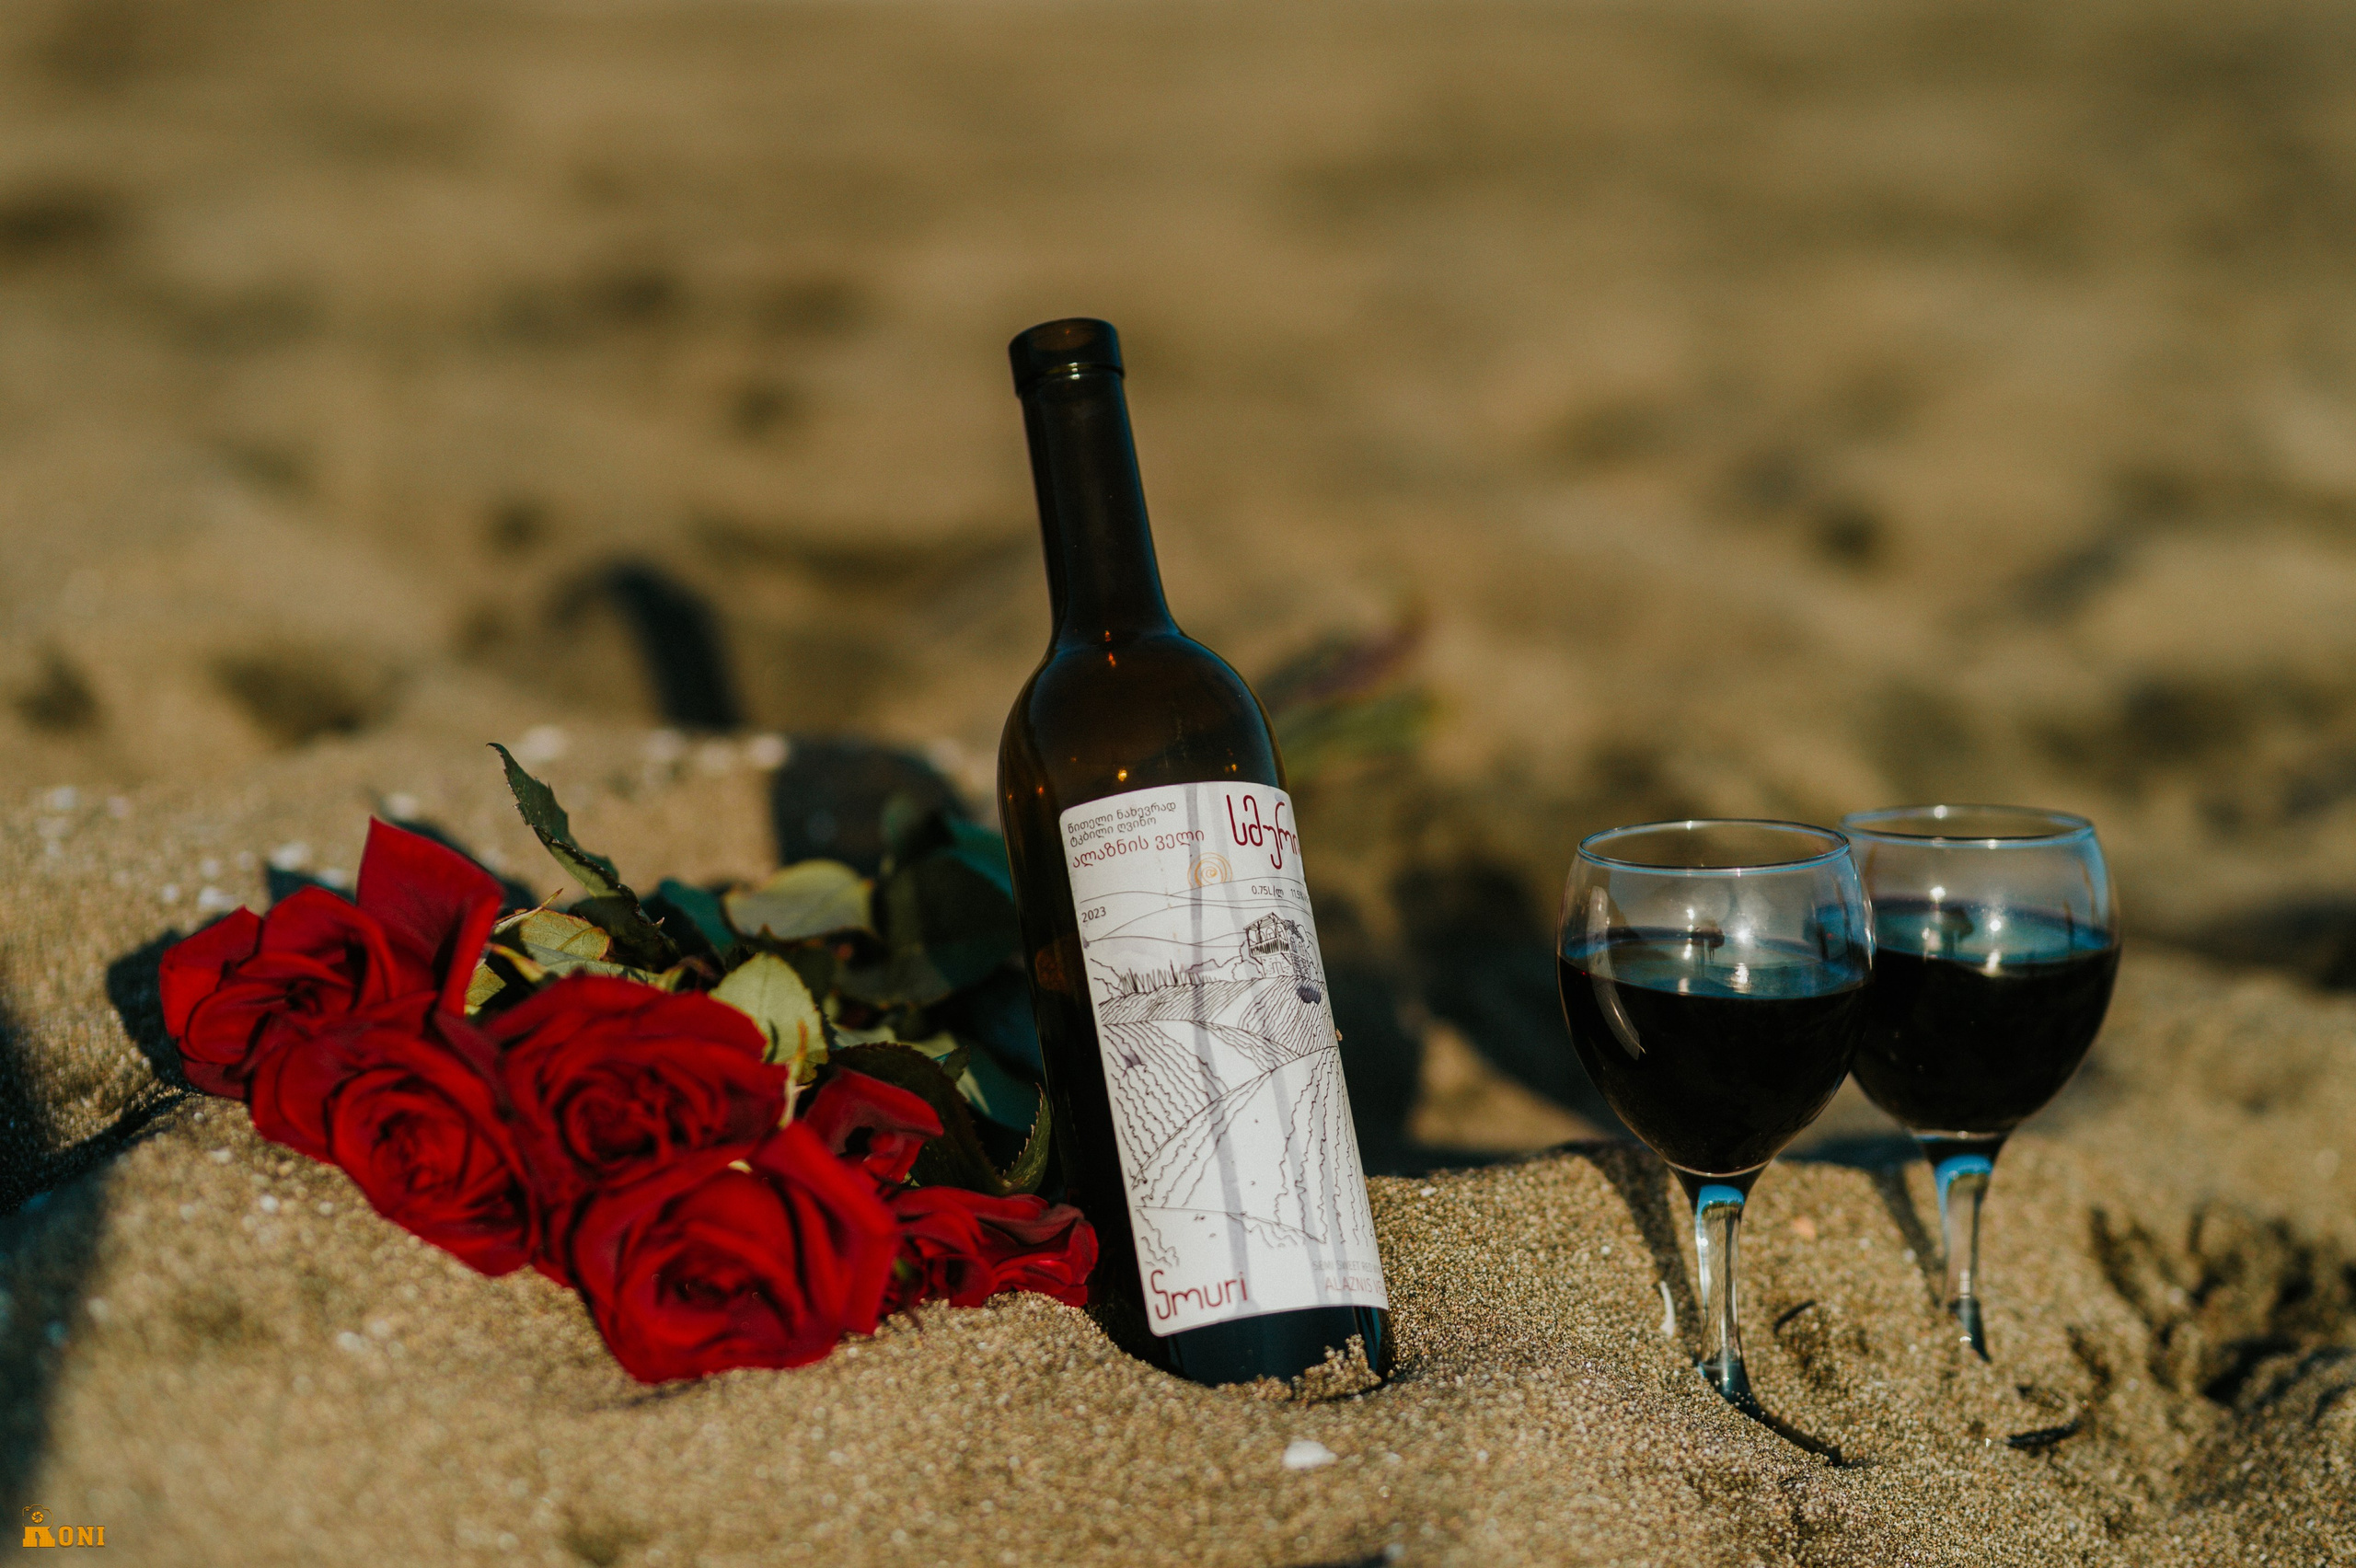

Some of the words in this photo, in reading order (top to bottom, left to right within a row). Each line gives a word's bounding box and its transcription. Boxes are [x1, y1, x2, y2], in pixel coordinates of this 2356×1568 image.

[1116, 801, 1176, 819] ნახევრად
[1070, 825, 1114, 847] ტკბილი
[1117, 816, 1157, 833] ღვინო
[1072, 836, 1149, 868] ალაზნის
[1155, 830, 1205, 851] ველი
[1081, 906, 1106, 923] 2023
[1150, 1269, 1248, 1320] Smuri
[1325, 1276, 1373, 1293] ALAZNIS
